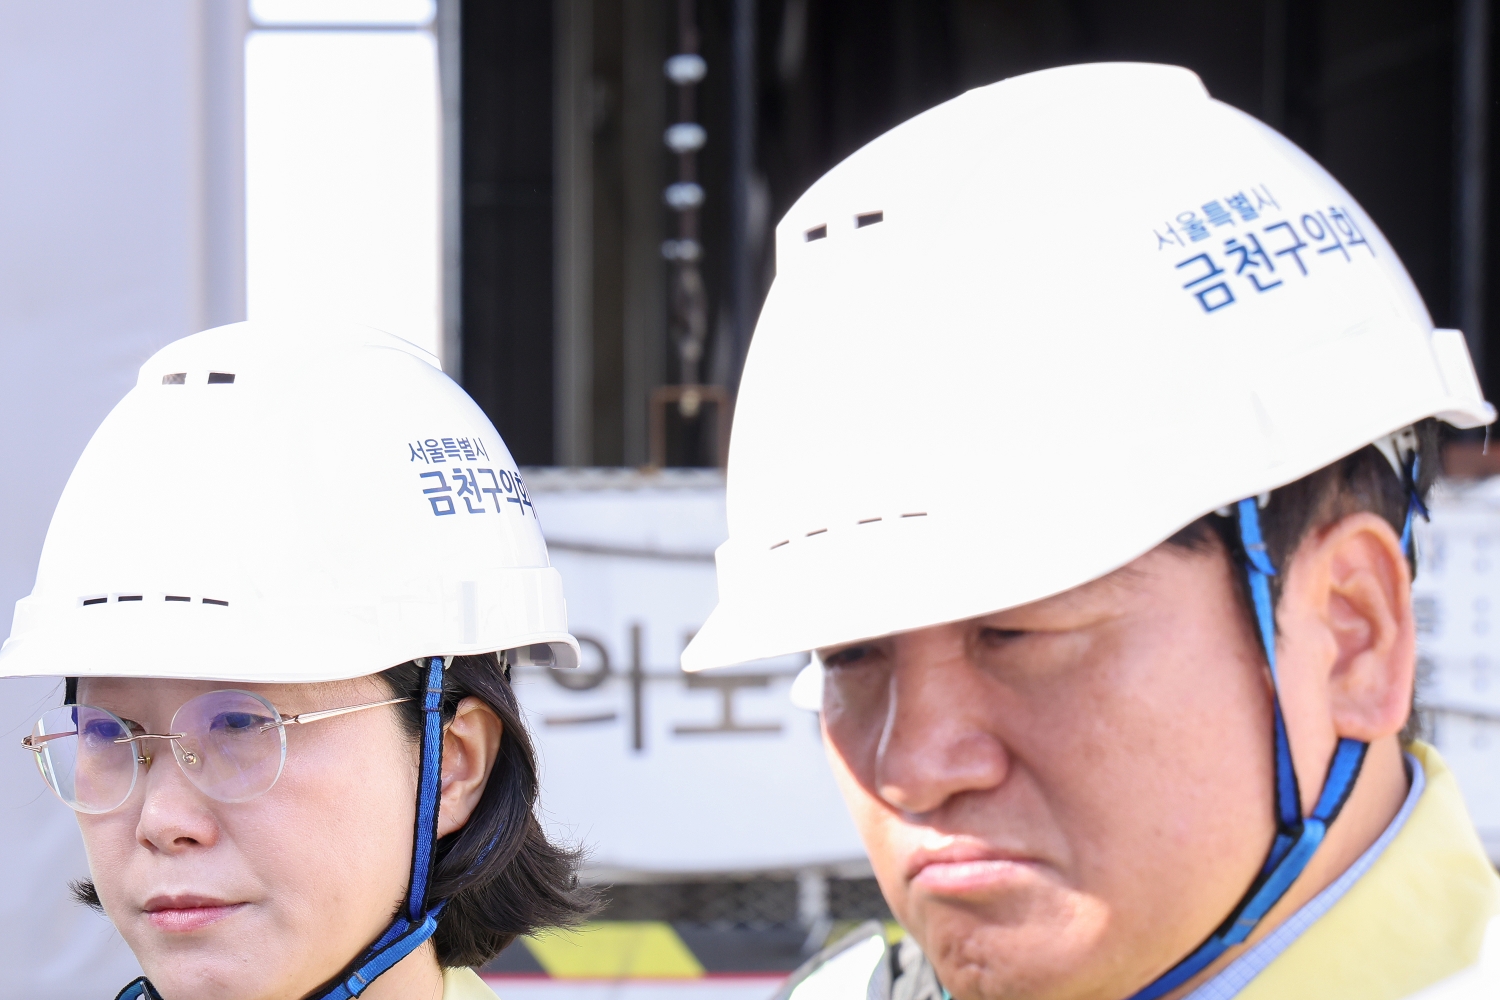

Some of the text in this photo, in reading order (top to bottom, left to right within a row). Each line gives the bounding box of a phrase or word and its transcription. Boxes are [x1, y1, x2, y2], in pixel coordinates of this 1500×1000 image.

[1152, 183, 1281, 251] 서울특별시
[1174, 206, 1377, 314] 금천구의회
[408, 437, 490, 464] 서울특별시
[419, 467, 537, 520] 금천구의회
